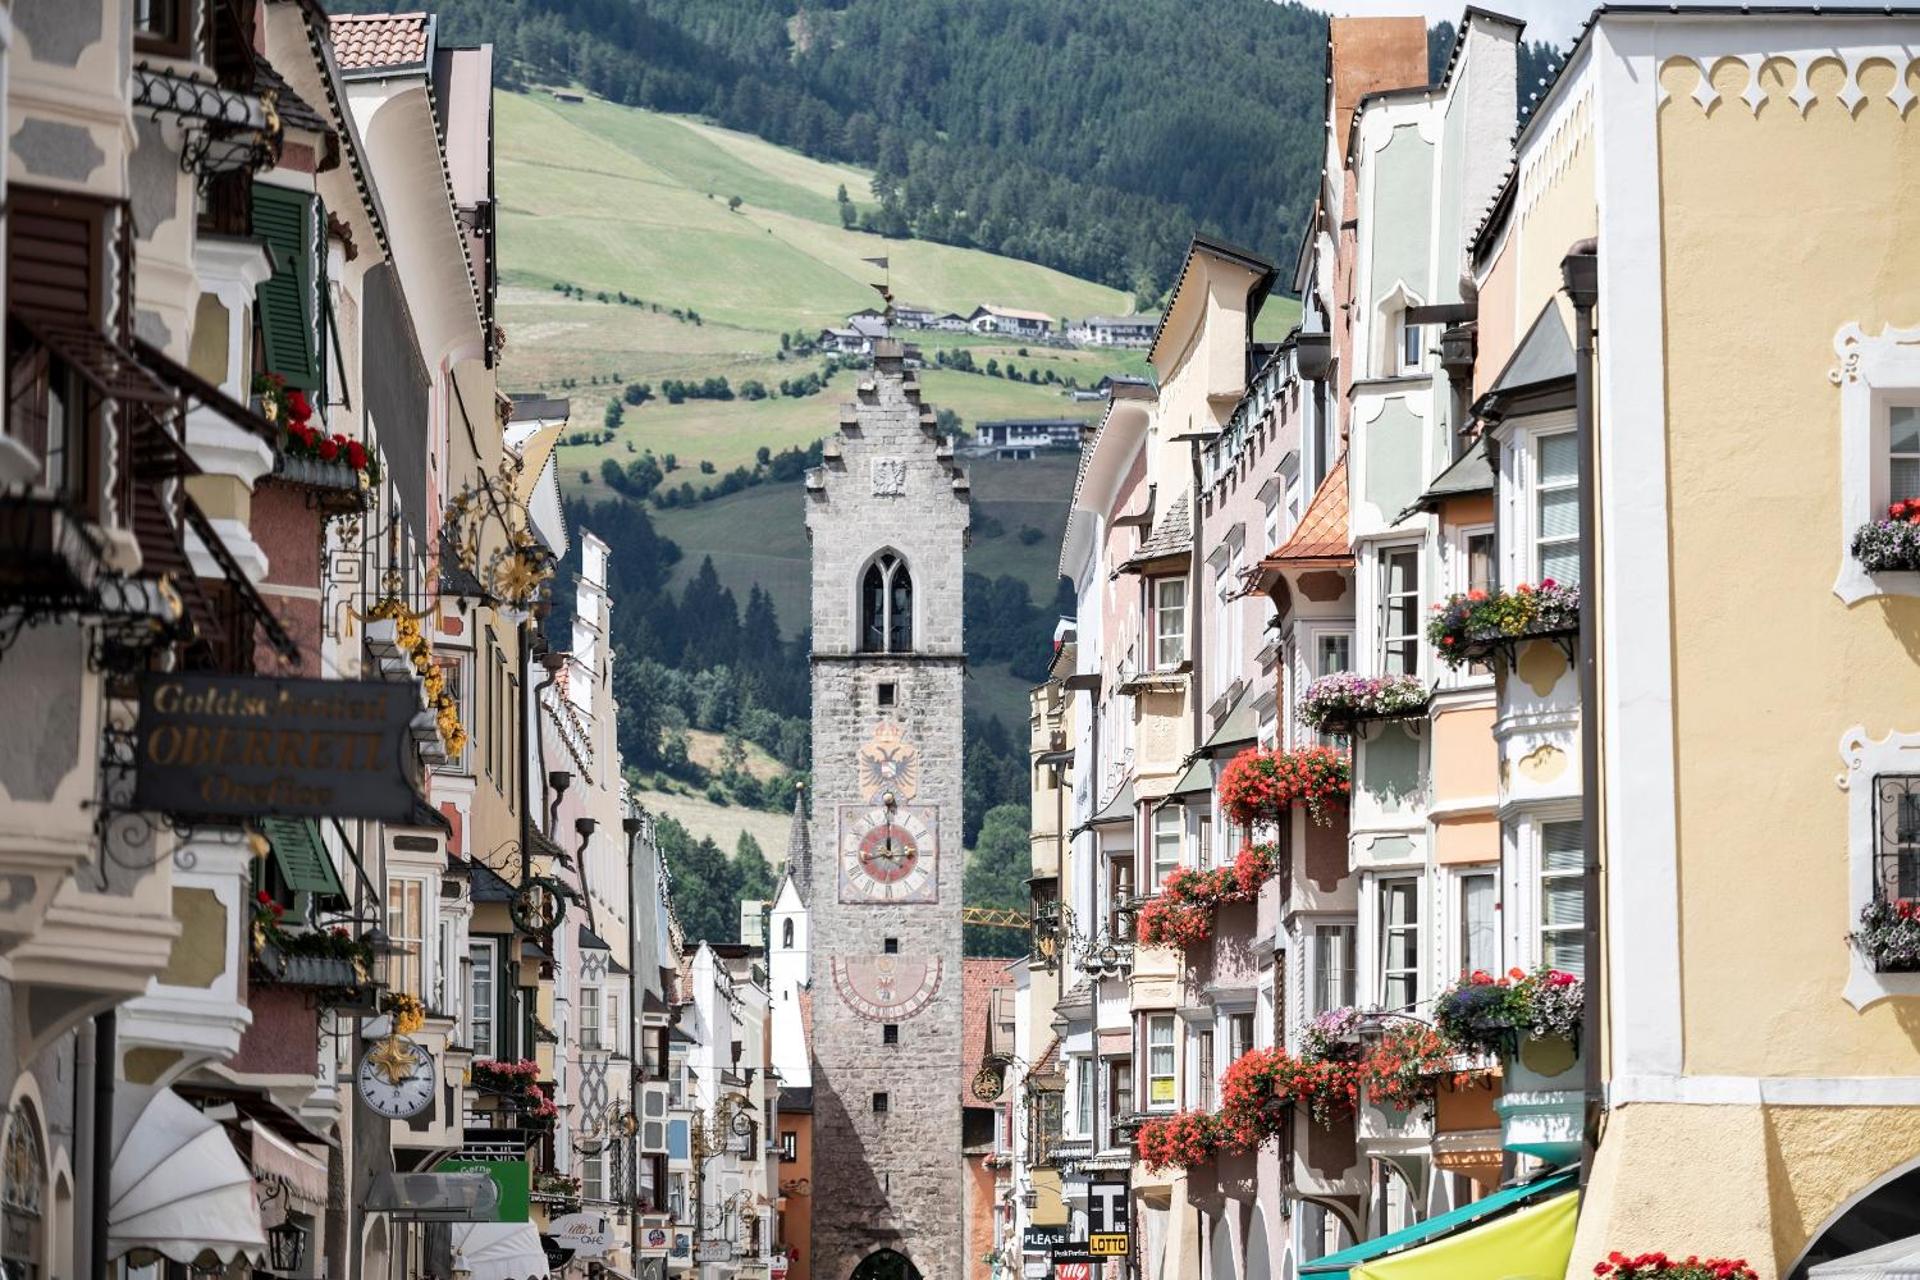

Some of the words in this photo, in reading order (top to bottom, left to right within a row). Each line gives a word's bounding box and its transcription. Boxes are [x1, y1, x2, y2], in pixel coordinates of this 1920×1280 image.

[1024, 1233, 1065, 1245] PLEASE
[1091, 1238, 1126, 1252] LOTTO
[1061, 1262, 1088, 1280] illy
